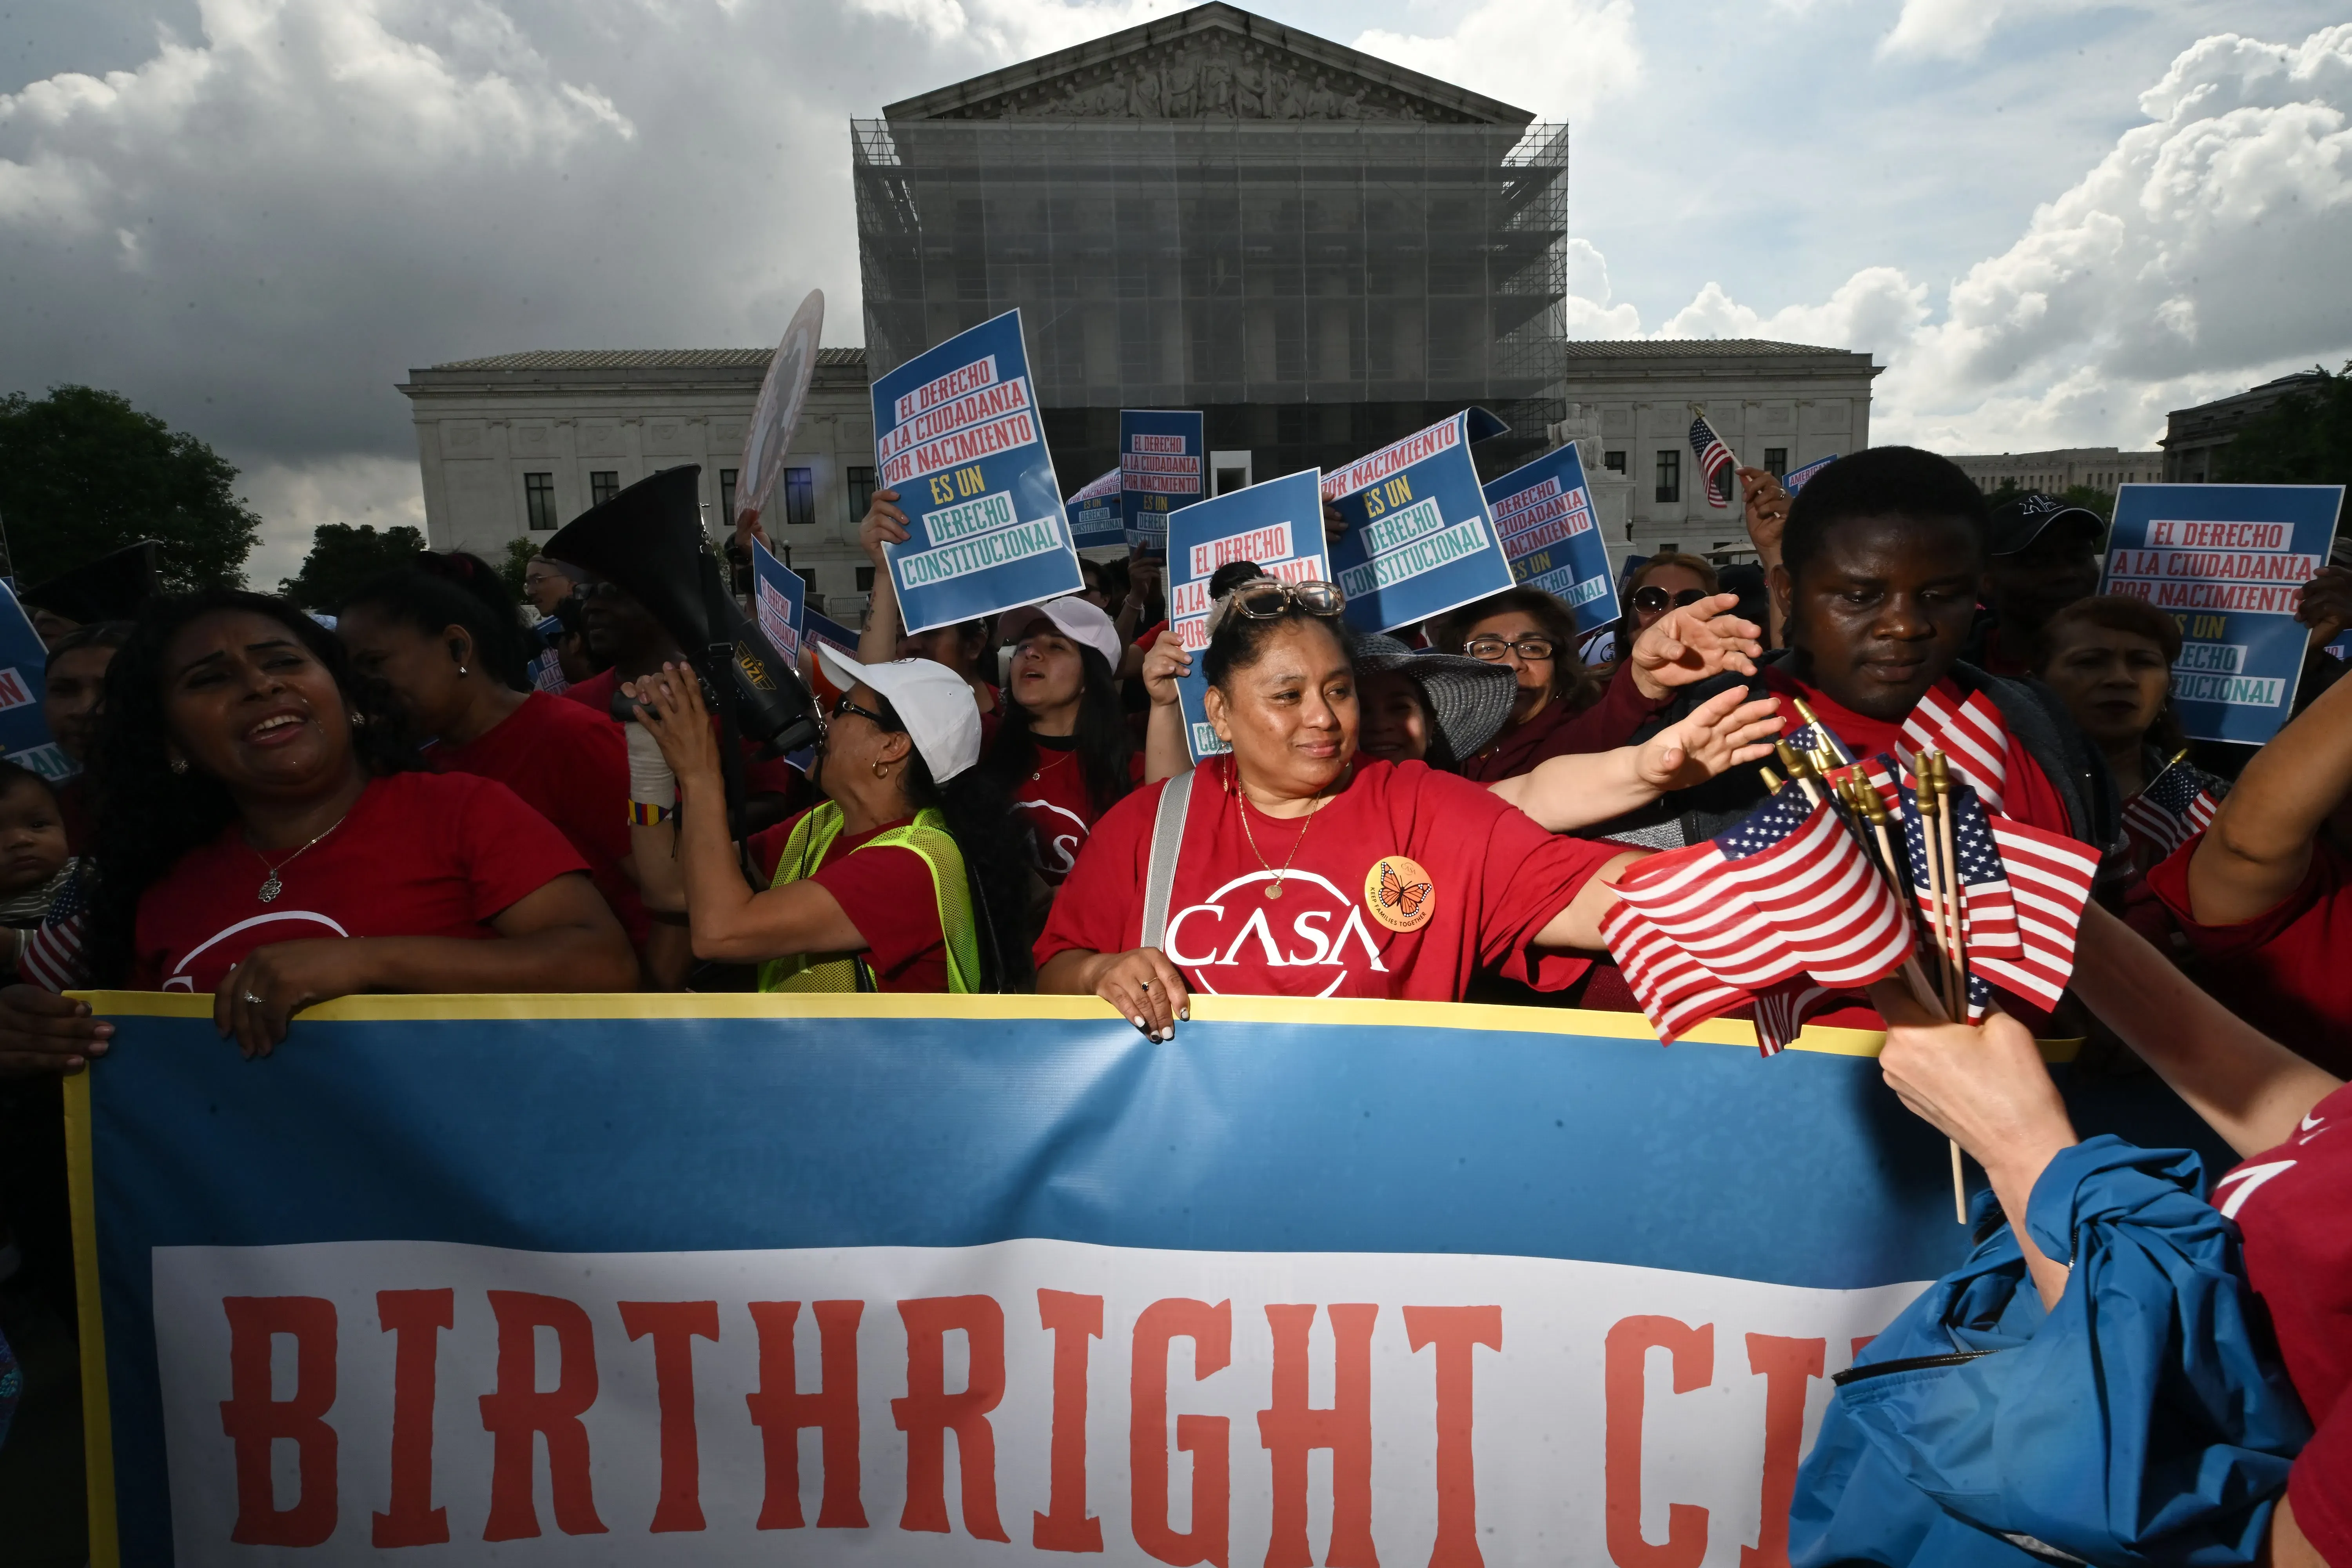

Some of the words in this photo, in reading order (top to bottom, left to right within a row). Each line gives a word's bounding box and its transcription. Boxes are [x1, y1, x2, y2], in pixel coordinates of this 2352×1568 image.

[900, 397, 916, 420] EL
[920, 360, 991, 408] DERECHO
[881, 439, 891, 461] A
[894, 425, 910, 450] LA
[915, 380, 1026, 441] CIUDADANÍA
[883, 454, 911, 487] POR
[916, 415, 1032, 472] NACIMIENTO
[1134, 436, 1142, 450] EL
[1145, 436, 1182, 452] DERECHO
[1353, 422, 1455, 490] NACIMIENTO
[1123, 455, 1128, 469] A
[1131, 455, 1139, 470] LA
[1142, 456, 1198, 473] CIUDADANÍA
[929, 475, 953, 505] ES
[957, 465, 985, 497] UN
[1082, 484, 1119, 500] NACIMIENTO
[1124, 474, 1138, 489] POR
[1140, 475, 1198, 492] NACIMIENTO
[1363, 491, 1385, 518] ES
[1384, 475, 1413, 505] UN
[1496, 480, 1555, 517] DERECHO
[1080, 509, 1108, 521] DERECHO
[1084, 501, 1091, 509] ES
[1093, 498, 1101, 507] UN
[1143, 495, 1153, 510] ES
[1156, 496, 1168, 511] UN
[927, 502, 1011, 542] DERECHO
[1139, 514, 1167, 530] DEREC
[1365, 502, 1438, 554] DERECHO
[2153, 522, 2174, 545] EL
[2182, 523, 2283, 548] DERECHO
[902, 521, 1058, 586] CONSTITUCIONAL
[1196, 546, 1209, 574] EL
[1214, 526, 1285, 569] DERECHO
[1342, 522, 1485, 597] CONSTITUCIONAL
[1509, 560, 1527, 581] ES
[1529, 551, 1552, 574] UN
[2113, 551, 2127, 574] A
[2134, 552, 2160, 575] LA
[2167, 552, 2312, 581] CIUDADANÍA
[767, 584, 788, 620] DERECHO
[1176, 588, 1184, 615] A
[1189, 583, 1206, 612] LA
[2192, 615, 2227, 639] UN
[740, 657, 764, 683] UZI
[1401, 863, 1416, 875] CASA
[1374, 904, 1397, 926] FAMILIES
[1399, 911, 1426, 927] TOGETHER
[1165, 904, 1389, 972] CASA
[219, 1288, 1503, 1568] BIRTHRIGHT
